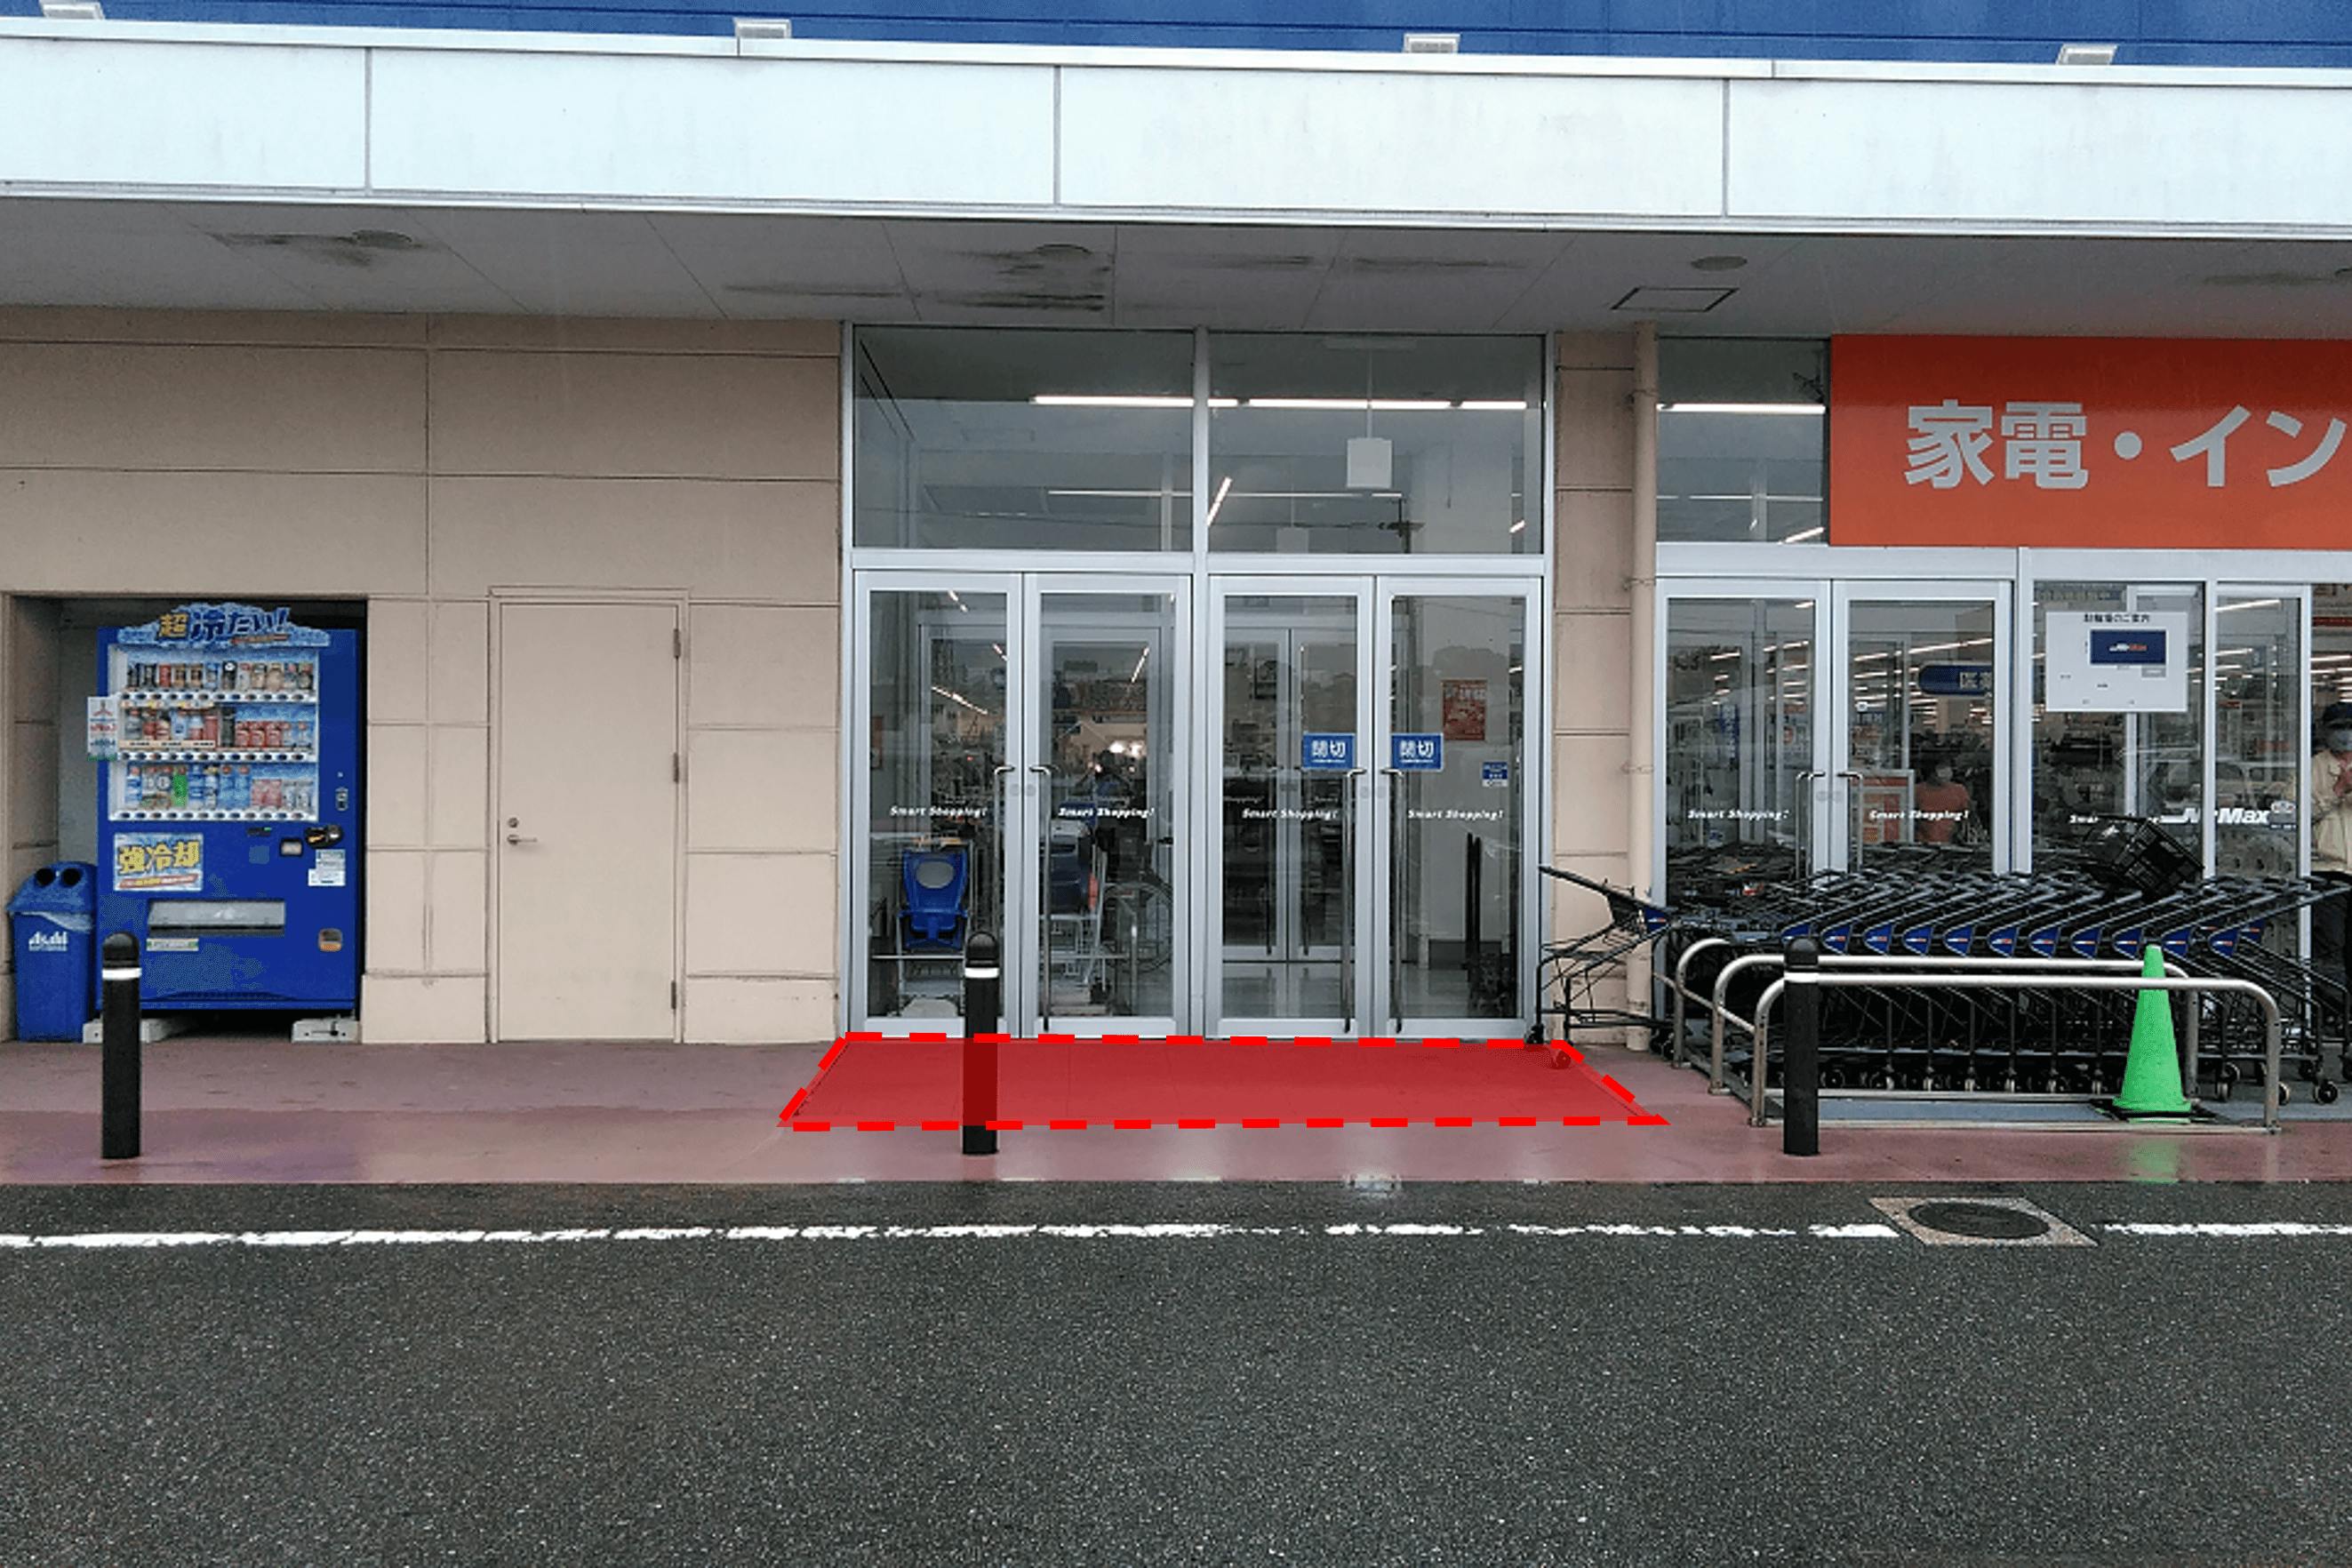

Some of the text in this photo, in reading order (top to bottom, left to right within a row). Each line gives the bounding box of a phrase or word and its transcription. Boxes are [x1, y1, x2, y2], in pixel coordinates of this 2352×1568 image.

[1904, 399, 2347, 489] 家電・イン
[890, 806, 926, 816] Smart
[1058, 807, 1093, 817] Smart
[1242, 808, 1277, 819] Smart
[1408, 810, 1443, 819] Smart
[1868, 810, 1905, 820] Smart
[118, 840, 201, 875] 強冷却
